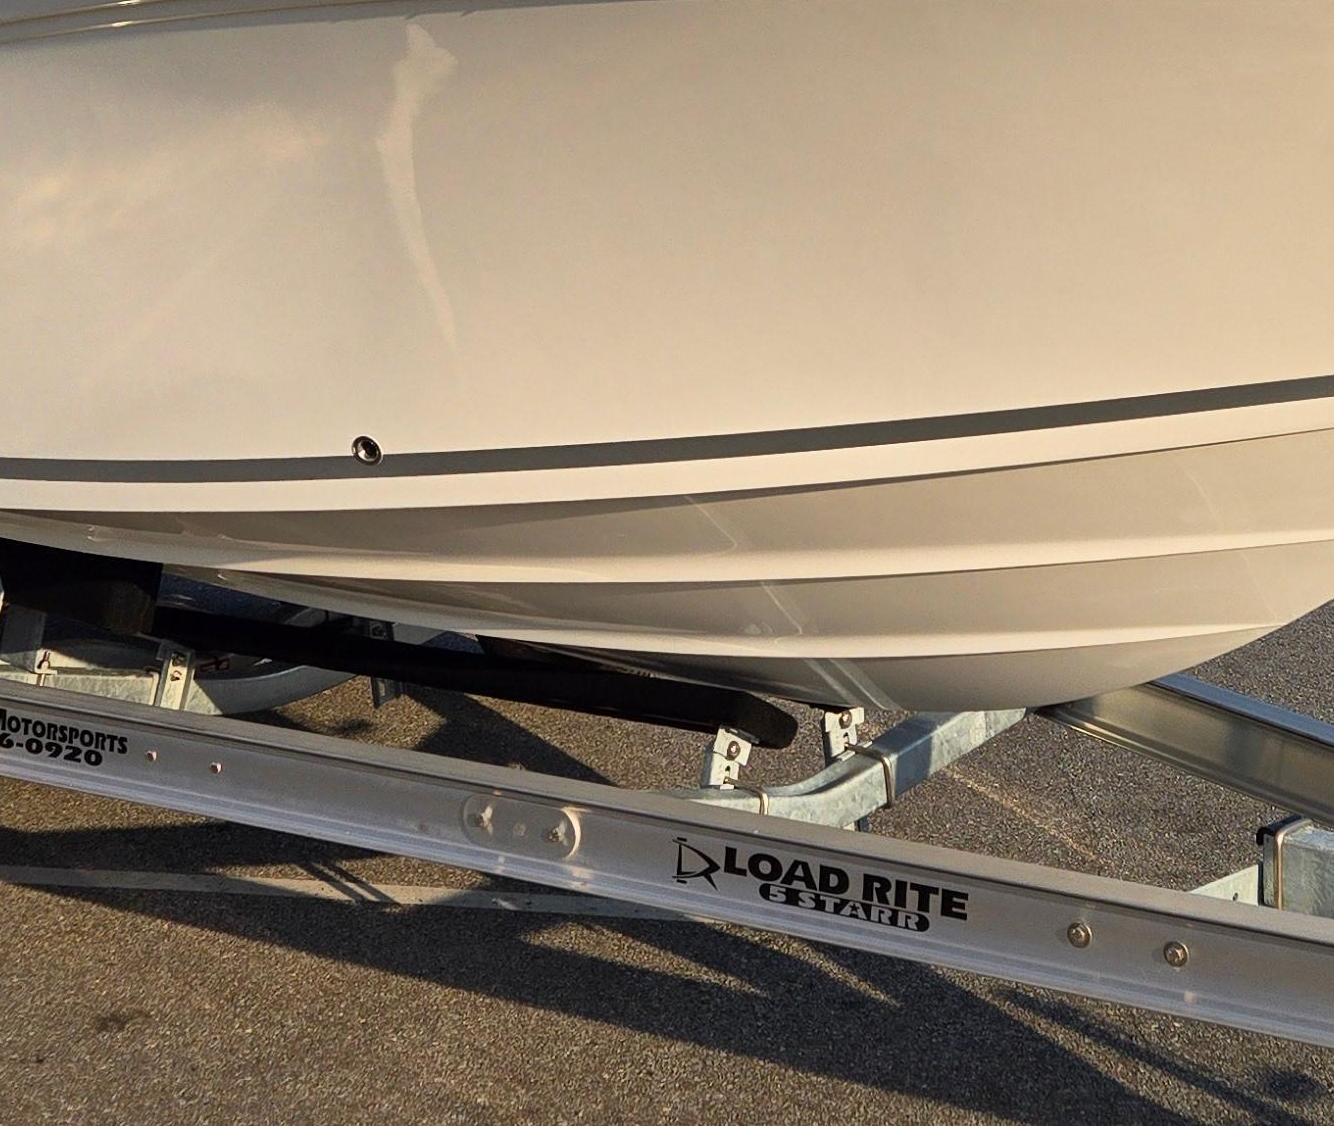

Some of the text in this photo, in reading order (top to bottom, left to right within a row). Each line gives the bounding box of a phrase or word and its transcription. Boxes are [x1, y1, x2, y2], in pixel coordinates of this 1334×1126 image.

[723, 846, 969, 921] LOAD RITE
[768, 884, 921, 931] 5 STARR
